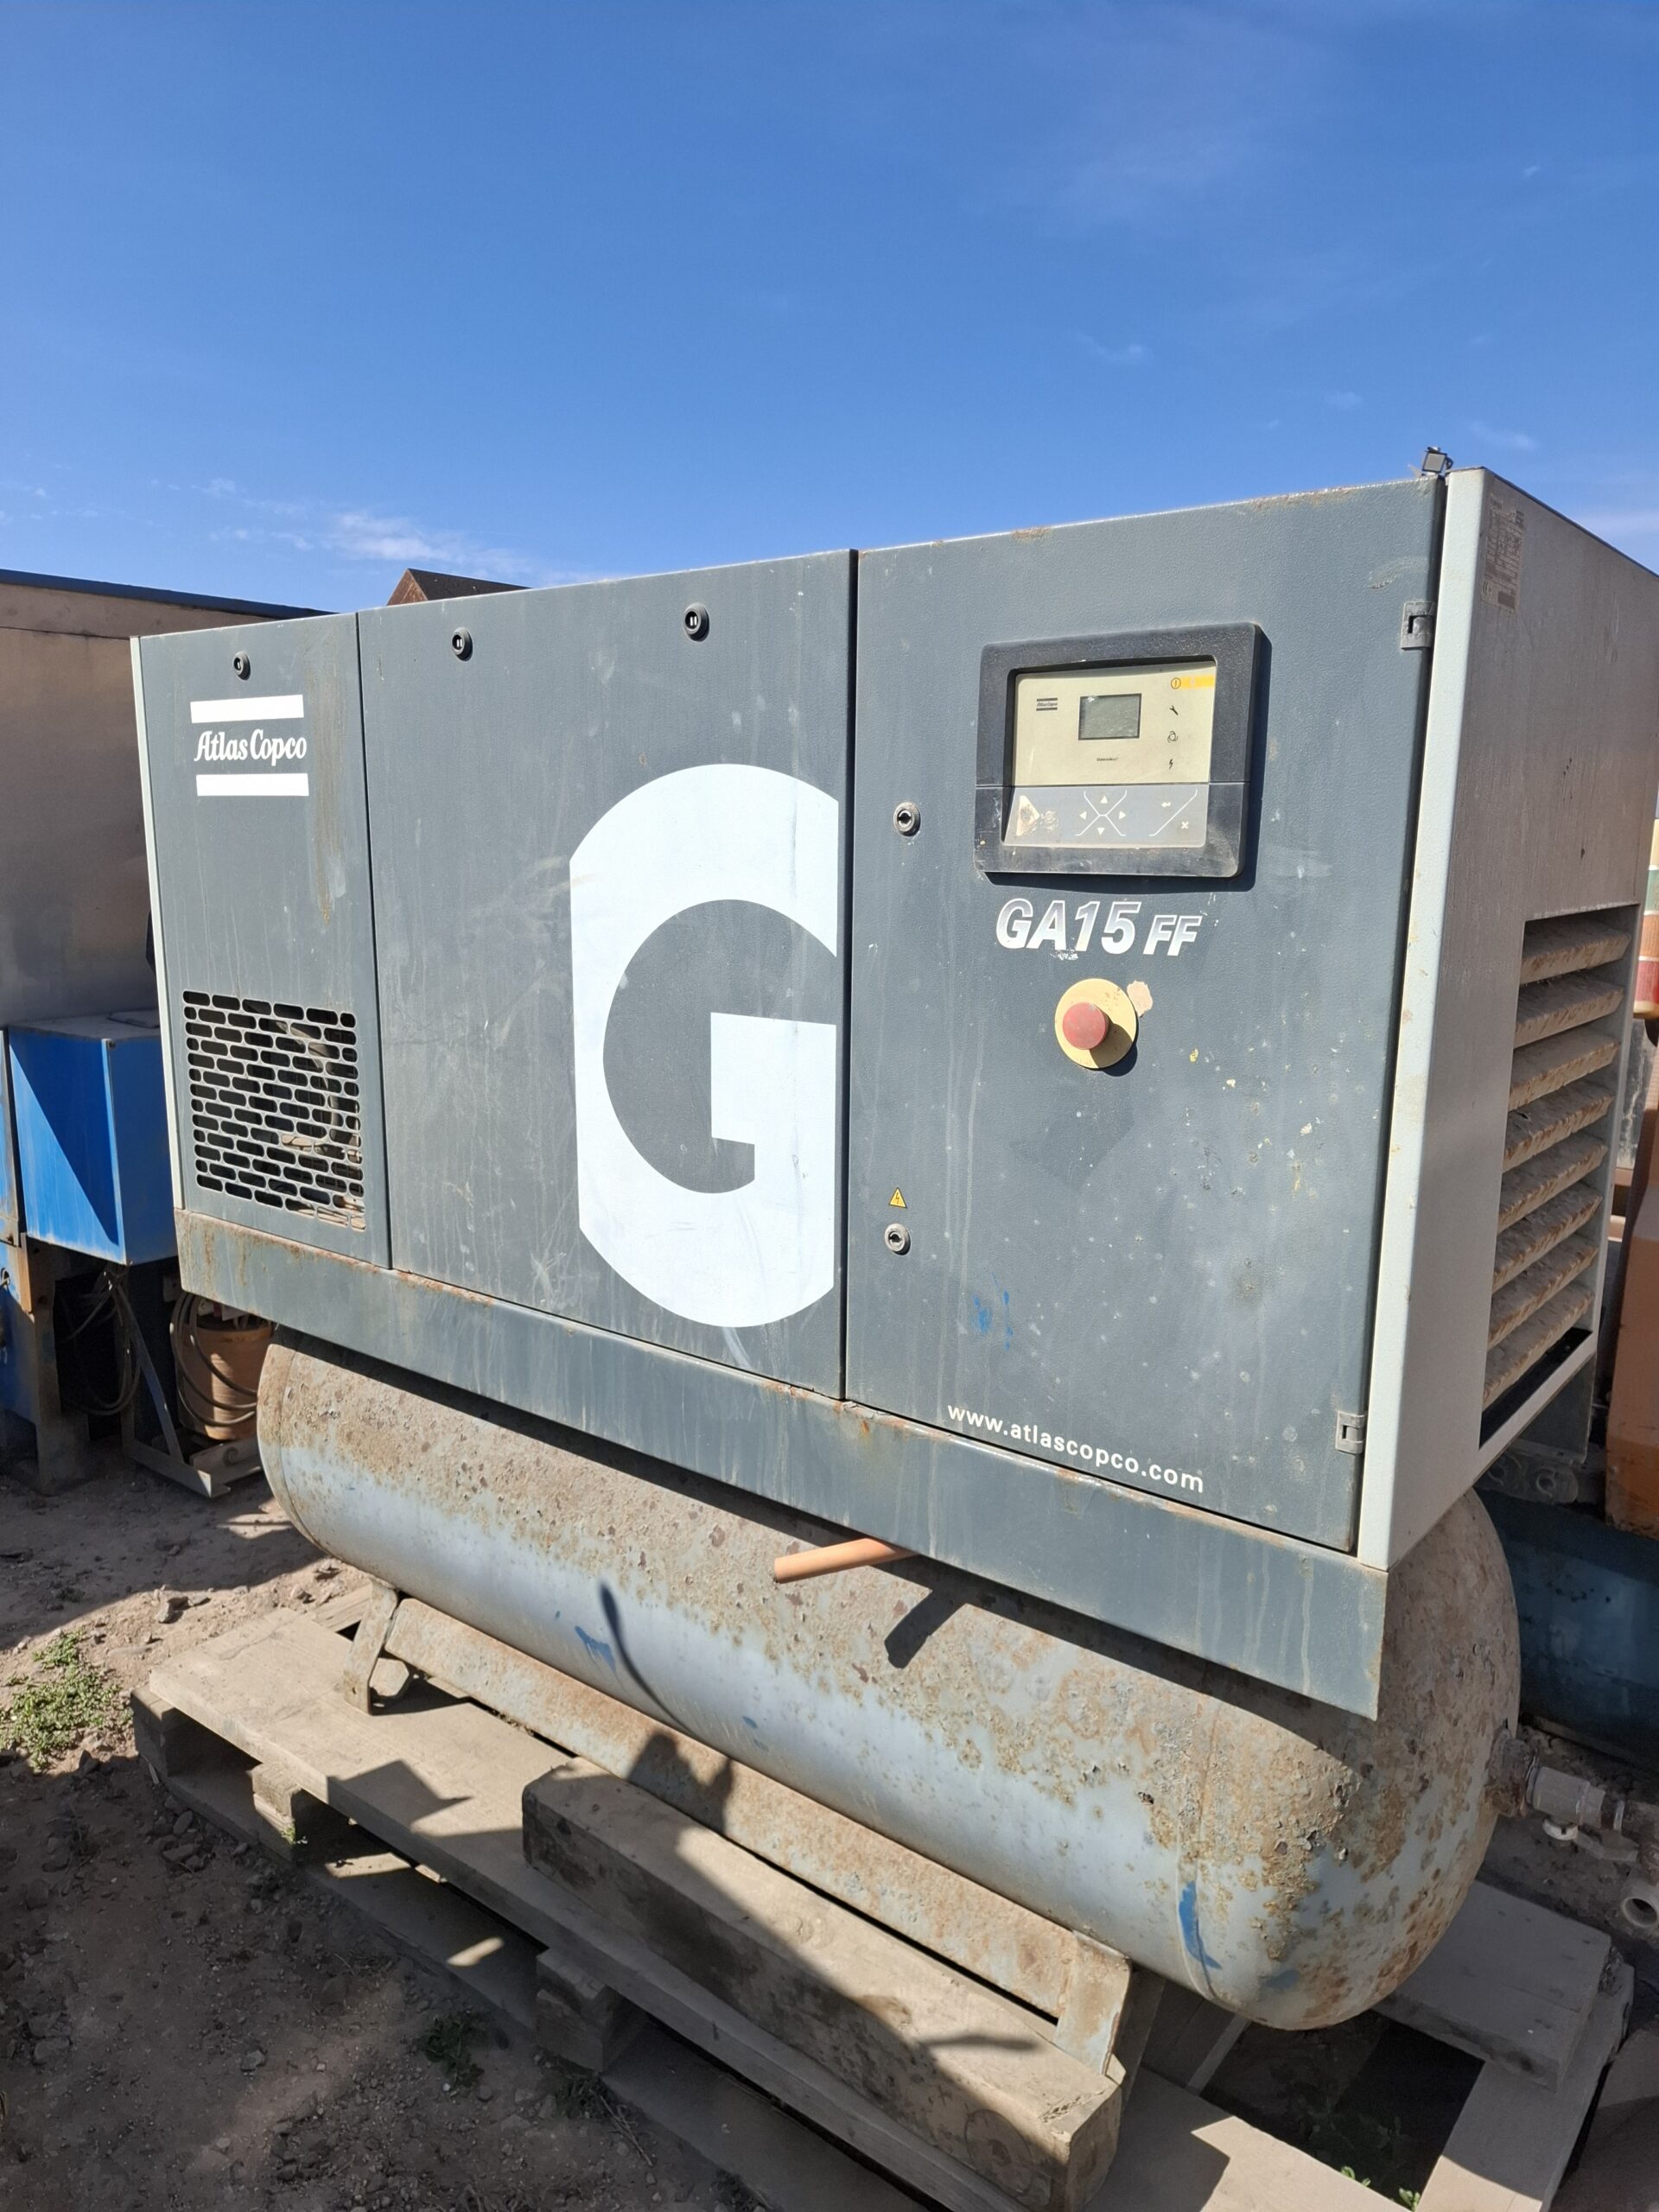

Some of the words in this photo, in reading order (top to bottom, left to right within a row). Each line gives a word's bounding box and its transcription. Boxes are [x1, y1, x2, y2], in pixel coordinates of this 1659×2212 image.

[194, 730, 249, 762] Atlas
[250, 728, 308, 767] Copco
[995, 897, 1142, 955] GA15
[1142, 914, 1204, 957] FF
[569, 762, 839, 1328] G
[947, 1405, 1205, 1494] www.atlascopco.com
